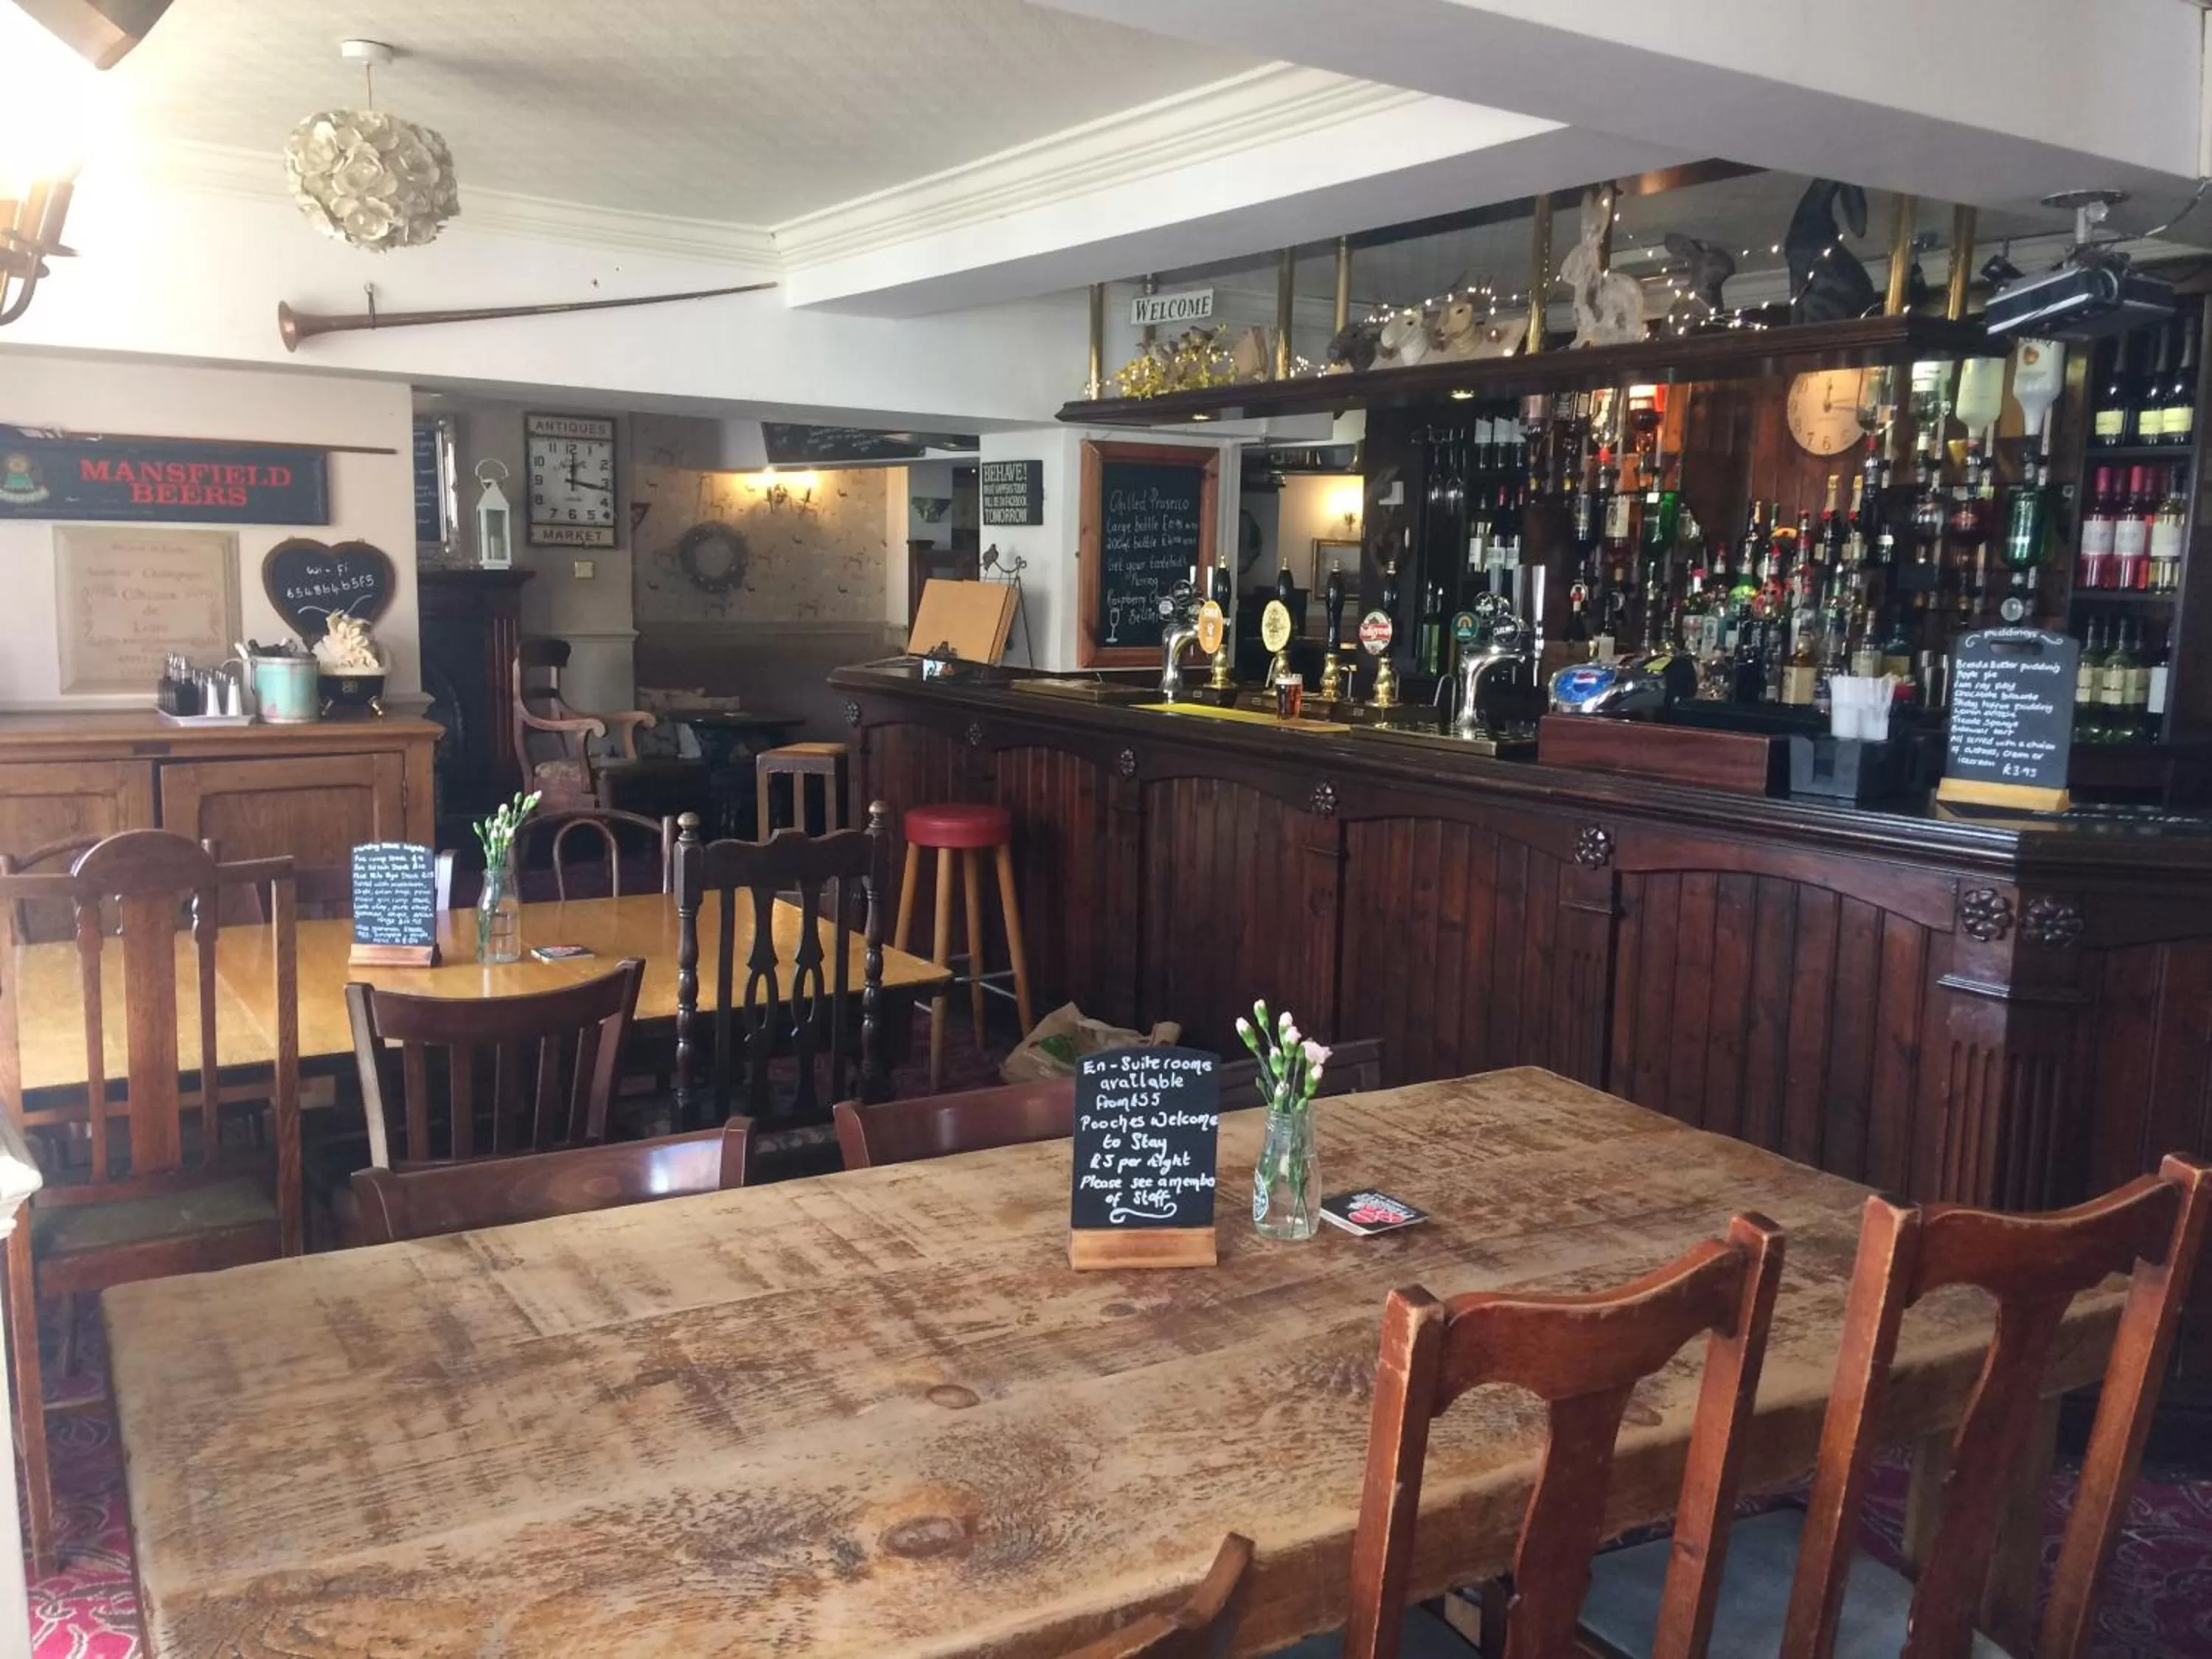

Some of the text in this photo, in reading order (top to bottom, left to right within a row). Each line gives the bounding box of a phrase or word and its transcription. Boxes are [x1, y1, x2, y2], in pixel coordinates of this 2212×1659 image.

[1136, 296, 1210, 321] WELCOME
[535, 421, 606, 435] ANTIQUES
[549, 442, 557, 453] 11
[566, 444, 577, 455] 12
[533, 455, 544, 467] 10
[600, 459, 609, 471] 2
[79, 458, 293, 487] MANSFIELD
[983, 463, 1027, 481] BEHAVE!
[535, 474, 543, 486] 9
[130, 481, 248, 507] BEERS
[535, 495, 543, 505] 8
[599, 498, 609, 507] 4
[549, 507, 558, 518] 7
[568, 509, 577, 520] 6
[586, 509, 597, 521] 5
[543, 530, 602, 541] MARKET
[1984, 628, 2039, 639] puddings
[1100, 1071, 1184, 1091] available
[1080, 1113, 1145, 1133] Pooches
[1102, 1132, 1167, 1156] to Stay
[1117, 1157, 1142, 1174] per
[1079, 1175, 1123, 1189] Please
[1130, 1178, 1154, 1189] see
[1157, 1178, 1167, 1188] a
[1105, 1192, 1124, 1208] of
